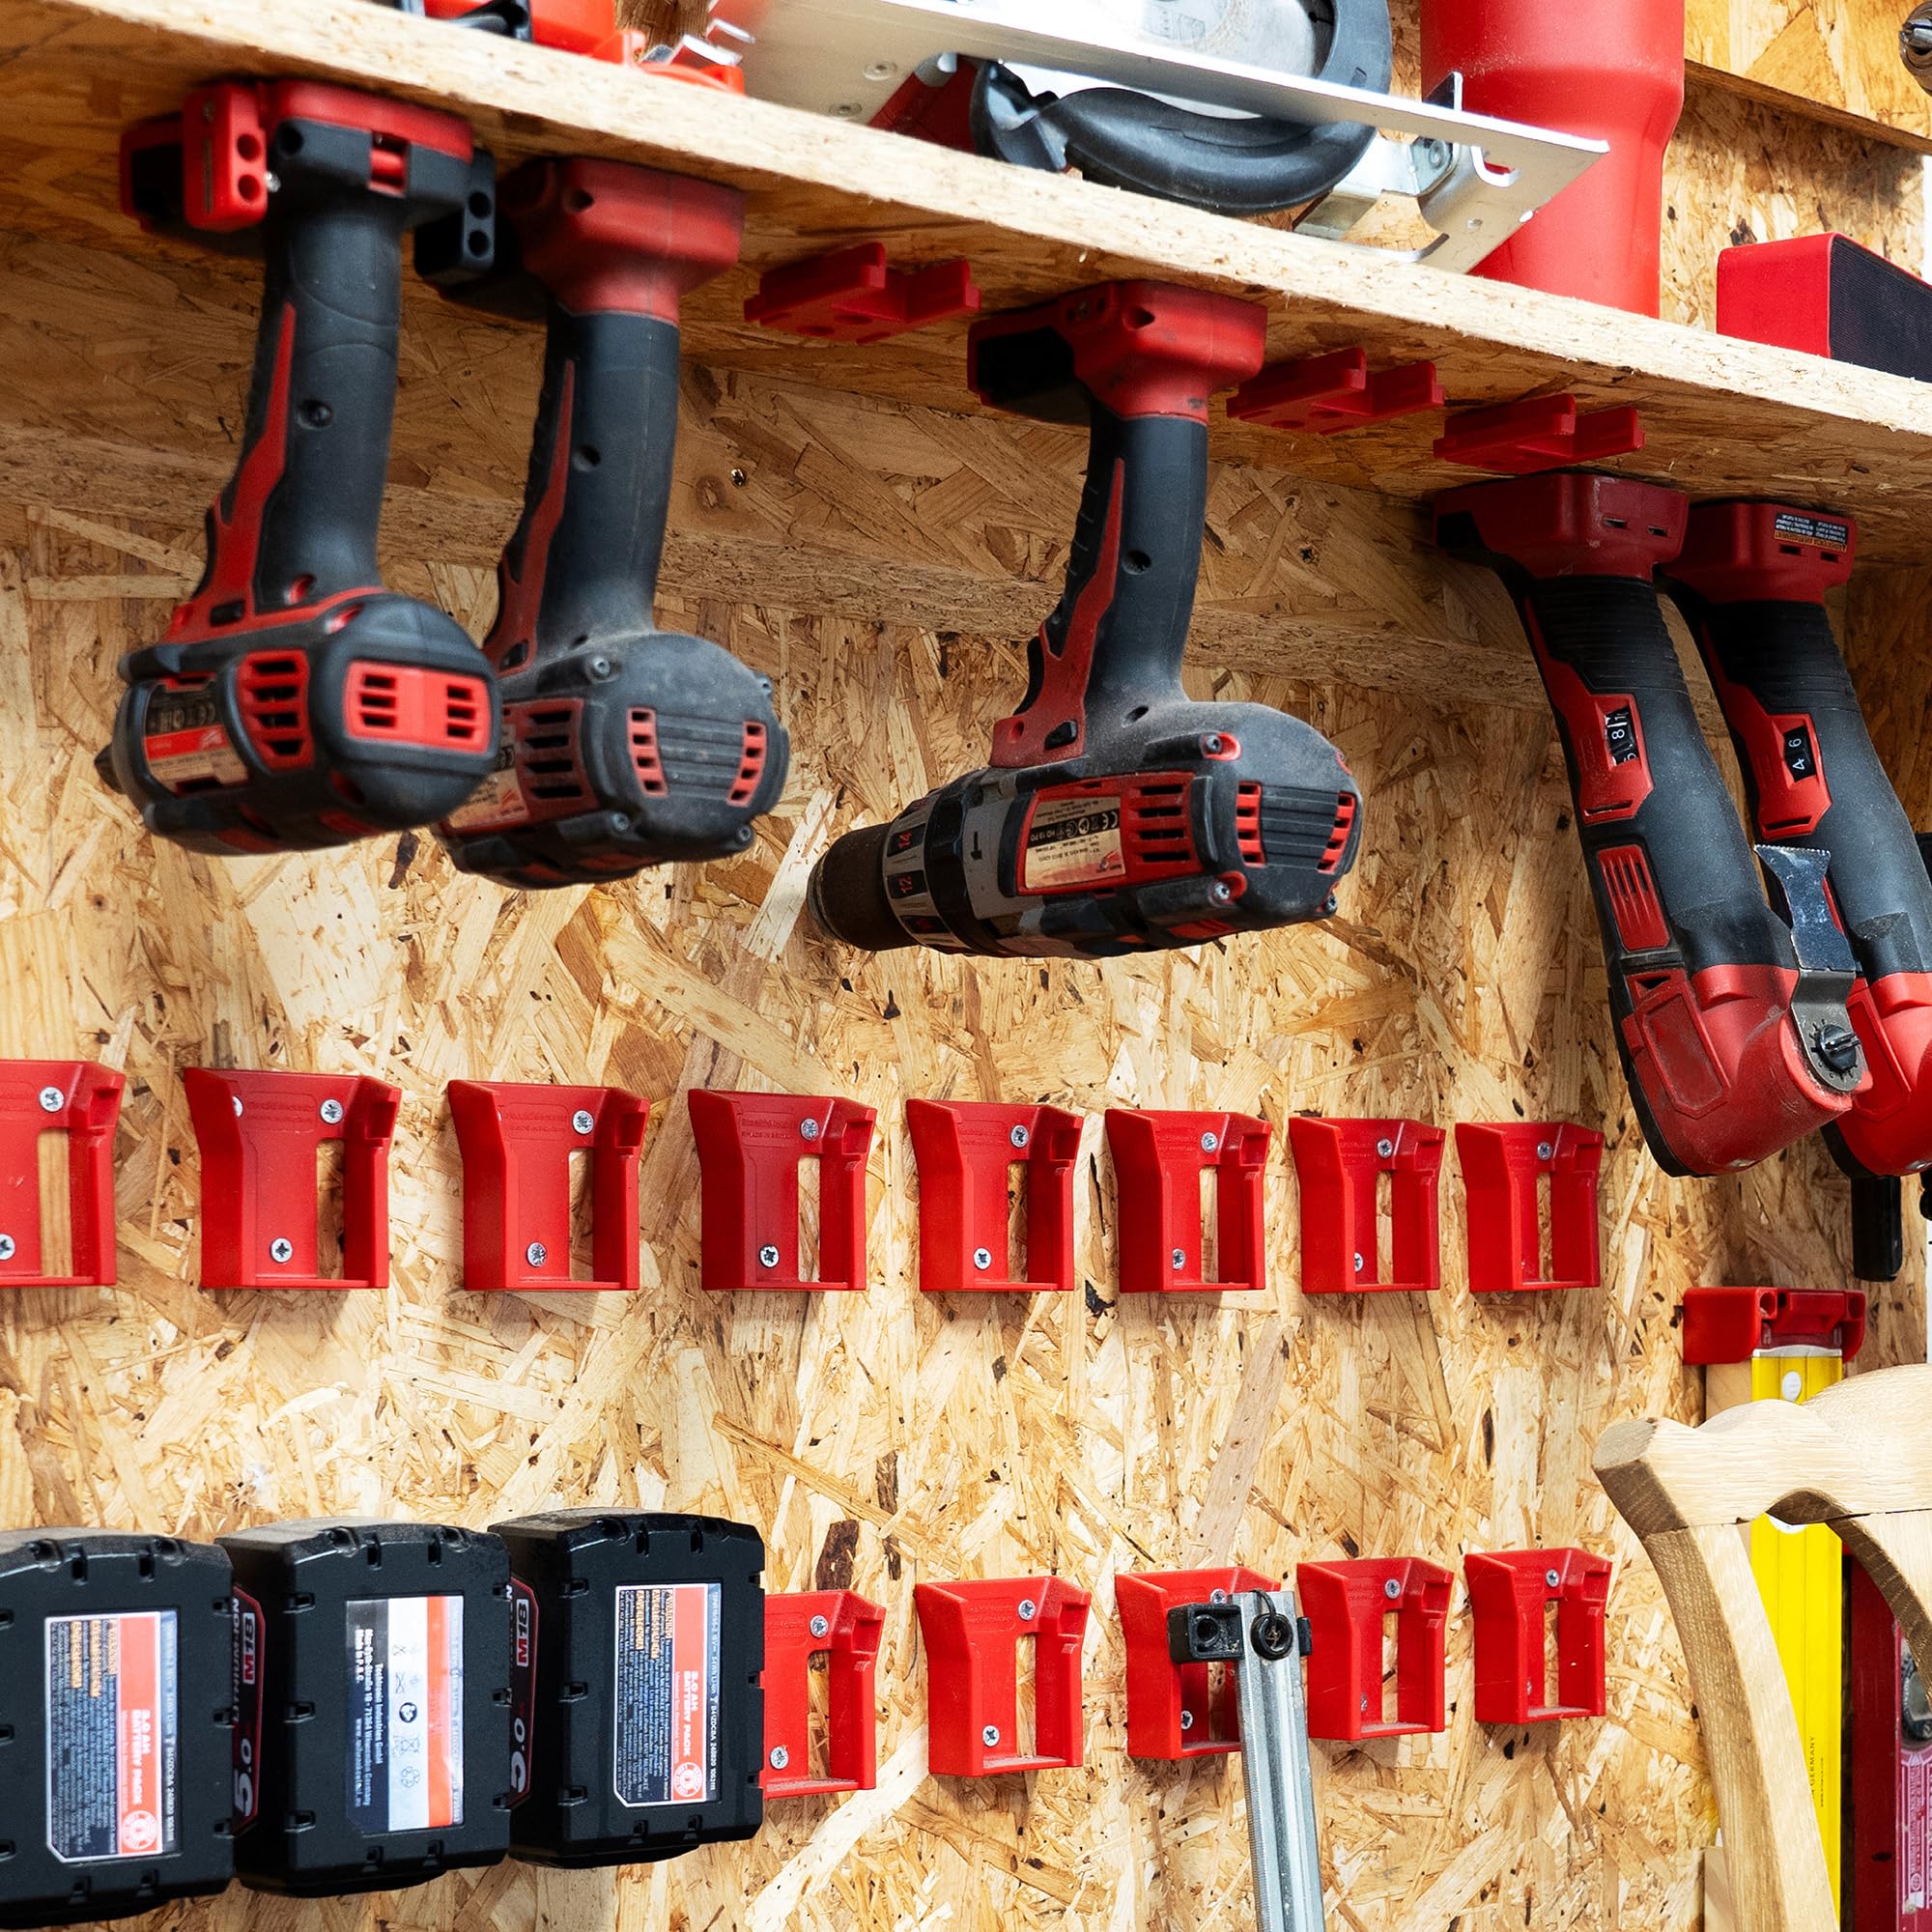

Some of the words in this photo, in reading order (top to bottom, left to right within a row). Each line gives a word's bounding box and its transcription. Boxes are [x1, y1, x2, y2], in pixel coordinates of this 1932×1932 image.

[1611, 729, 1625, 740] 8
[1788, 738, 1802, 748] 6
[1792, 758, 1805, 770] 4
[243, 1616, 254, 1682] M18
[355, 1629, 364, 1650] Made
[518, 1603, 527, 1663] M18
[375, 1663, 384, 1703] Techtronic
[691, 1693, 698, 1712] AH
[132, 1709, 142, 1766] BATTERY
[375, 1703, 384, 1741] Industries
[375, 1742, 384, 1764] GmbH
[132, 1768, 142, 1804] PACK
[235, 1738, 253, 1817] 5.0
[363, 1773, 372, 1806] Germany
